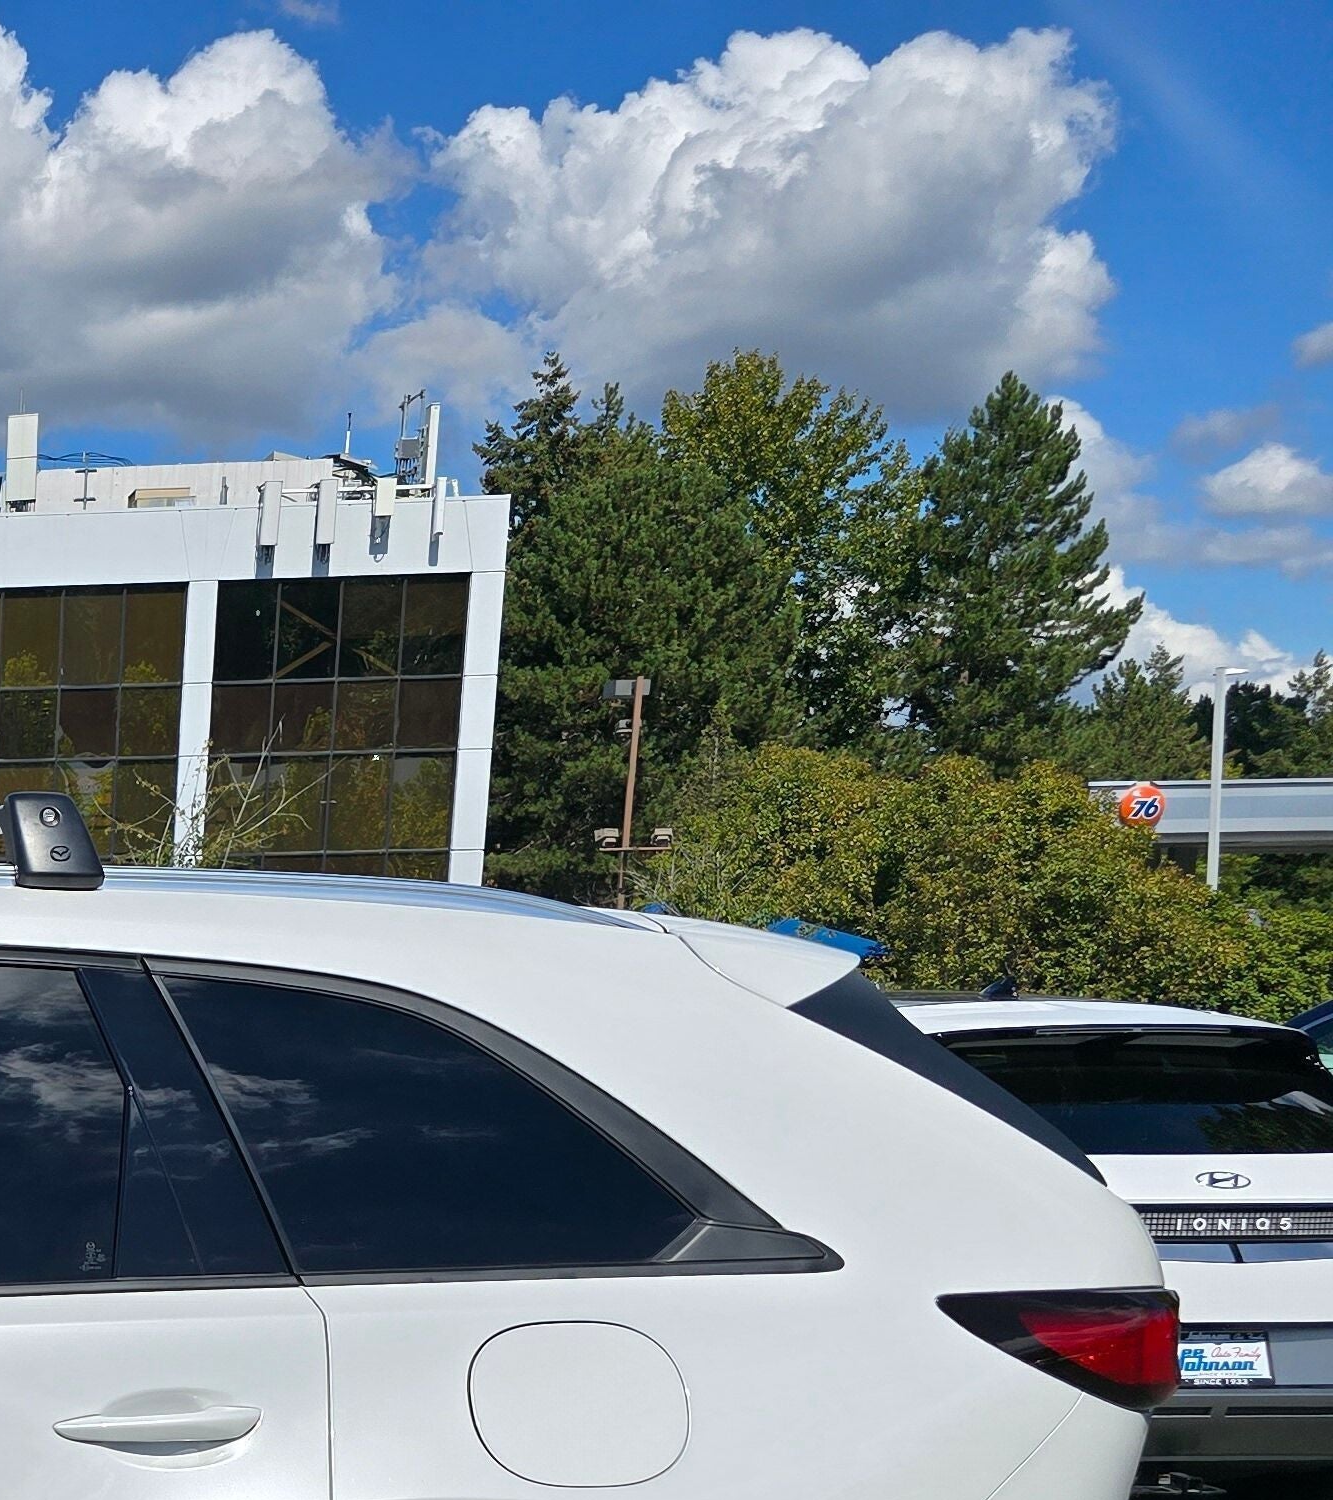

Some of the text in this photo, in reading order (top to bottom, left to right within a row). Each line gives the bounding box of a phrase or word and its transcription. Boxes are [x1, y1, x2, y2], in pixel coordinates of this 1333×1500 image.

[1129, 797, 1160, 818] 76
[1176, 1217, 1293, 1231] IONIQ 5
[1180, 1348, 1207, 1359] ee
